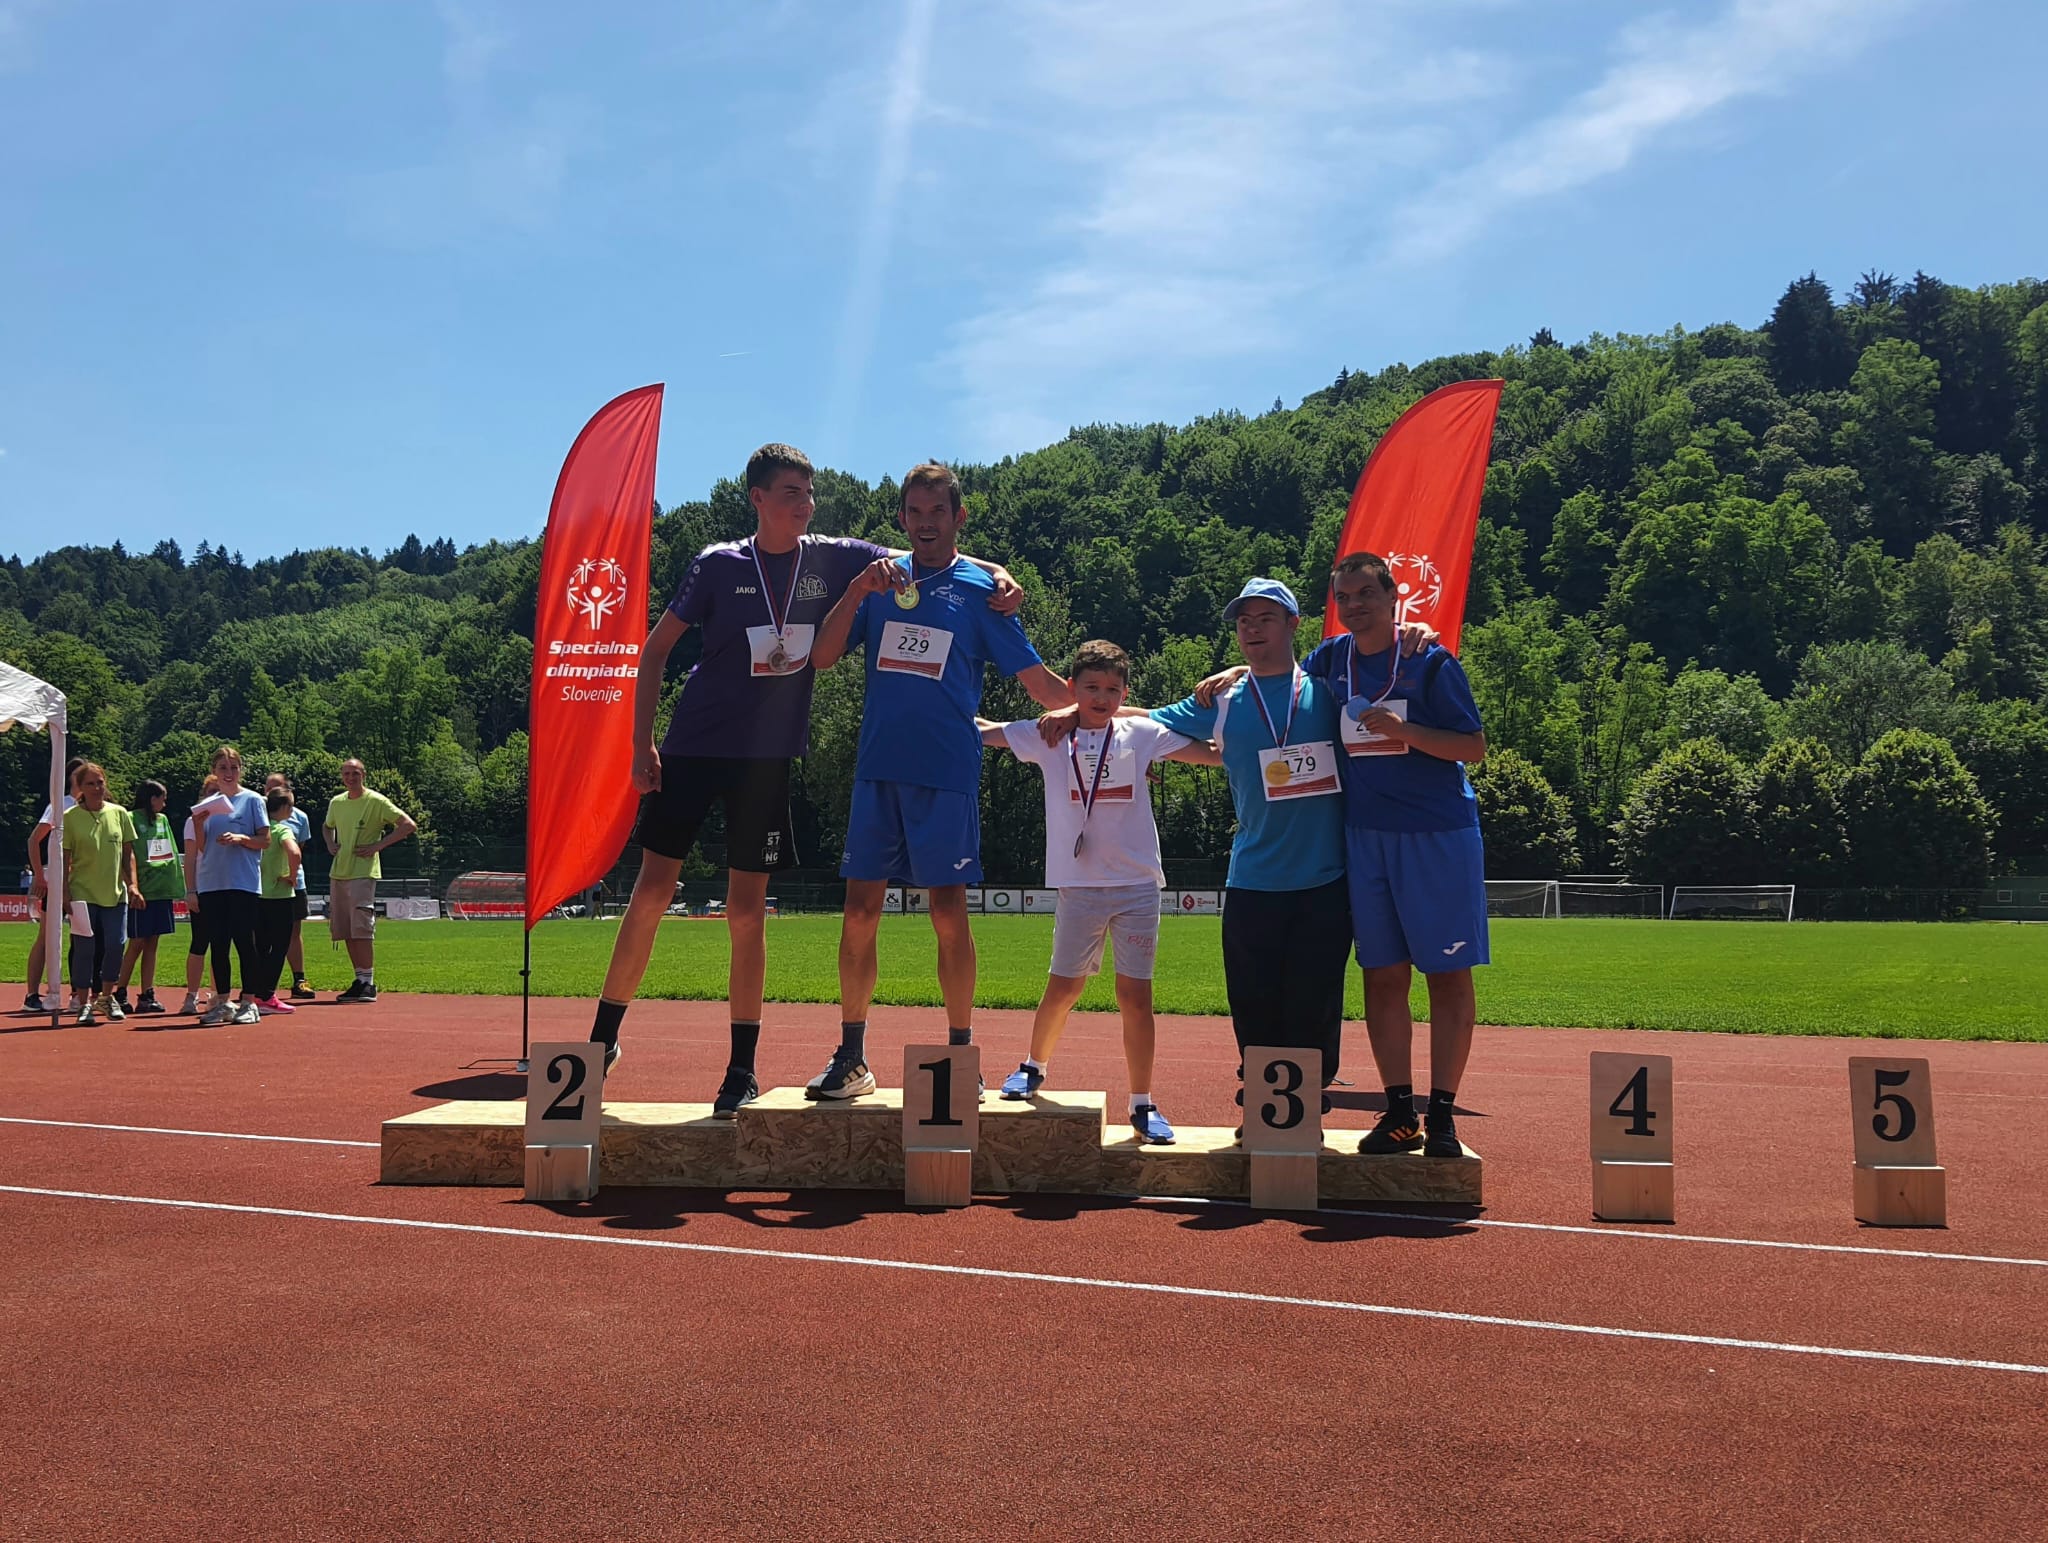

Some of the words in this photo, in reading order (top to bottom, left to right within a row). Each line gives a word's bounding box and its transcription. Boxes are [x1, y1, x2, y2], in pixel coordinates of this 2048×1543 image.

[735, 586, 757, 594] JAKO
[548, 640, 640, 657] Specialna
[897, 635, 930, 654] 229
[546, 663, 639, 681] olimpiada
[560, 685, 623, 705] Slovenije
[0, 901, 28, 917] trigla
[541, 1053, 587, 1121] 2
[918, 1057, 964, 1127] 1
[1260, 1059, 1305, 1130] 3
[1608, 1066, 1657, 1137] 4
[1871, 1068, 1917, 1143] 5
